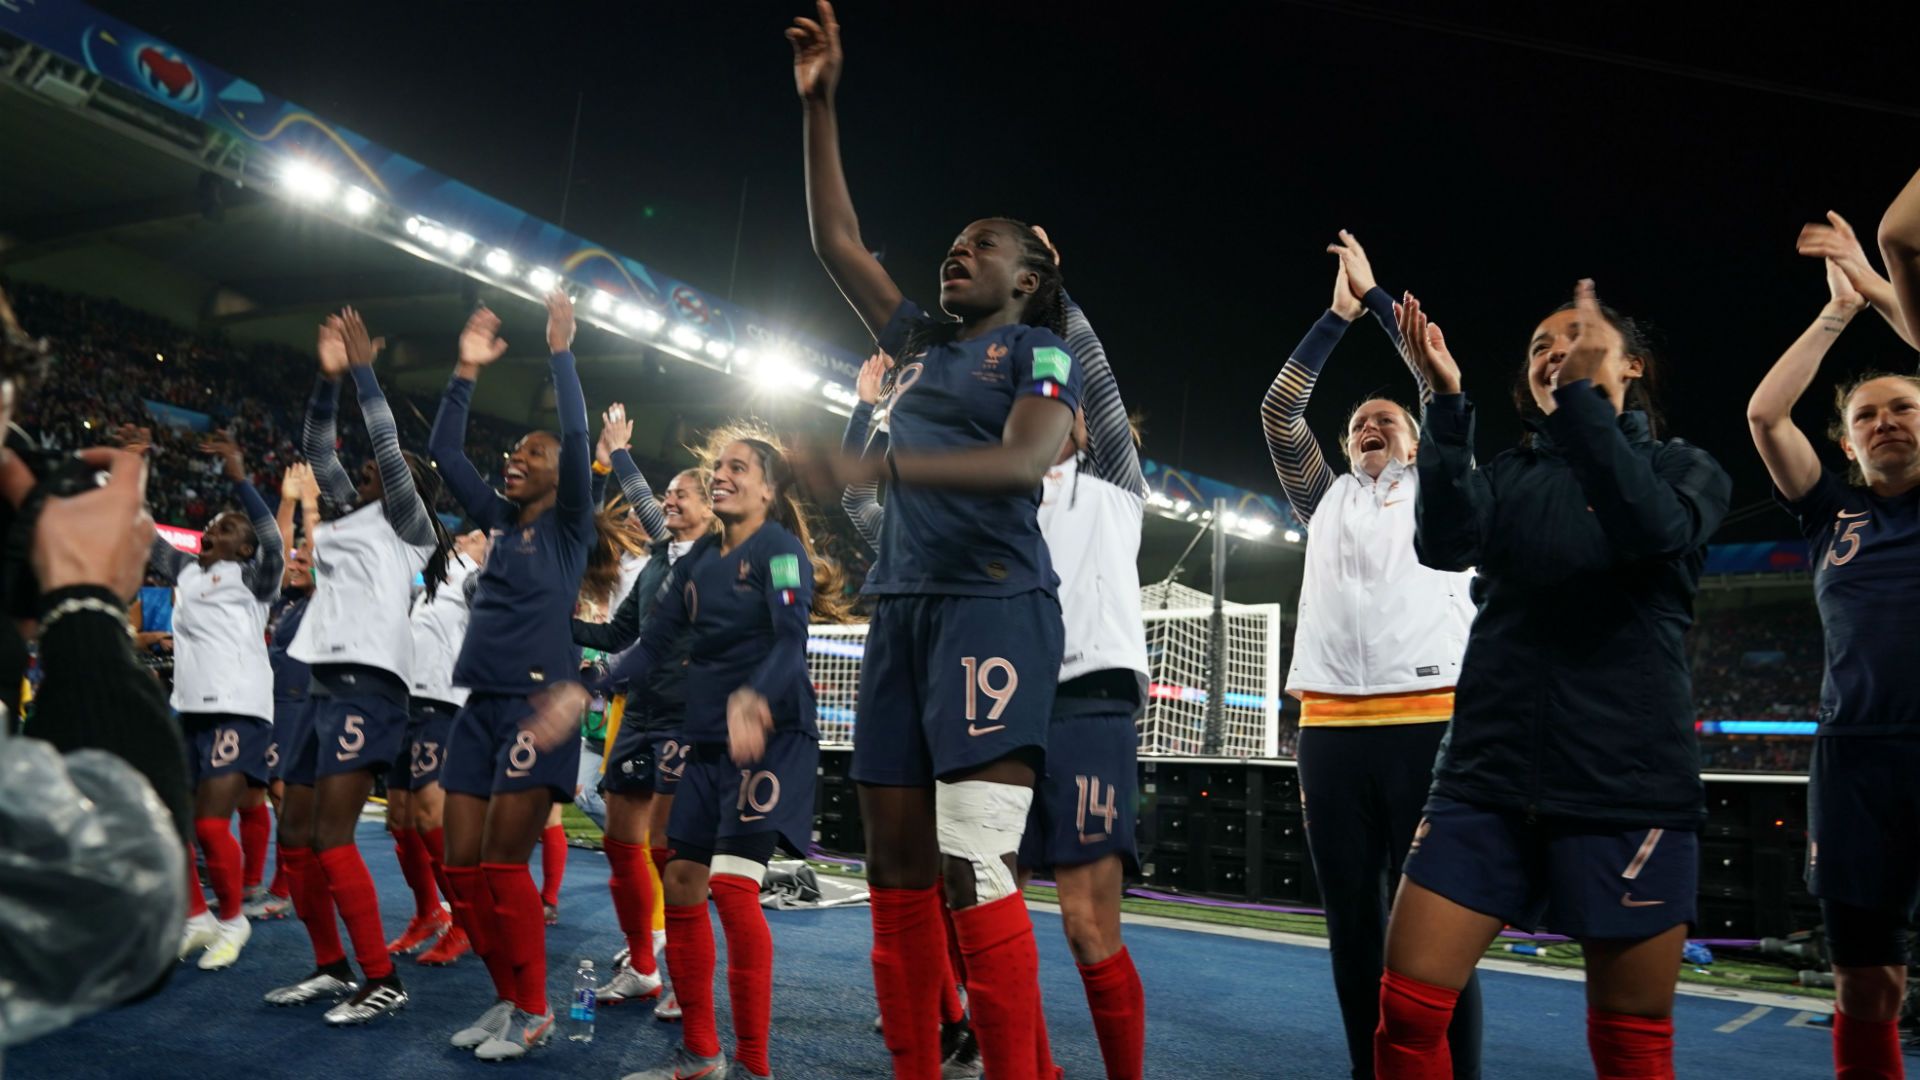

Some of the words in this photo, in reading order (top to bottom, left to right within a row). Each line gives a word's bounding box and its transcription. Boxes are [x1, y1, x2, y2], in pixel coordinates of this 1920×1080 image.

[1822, 519, 1870, 571] 15
[961, 656, 1019, 721] 19
[211, 728, 240, 763] 18
[338, 714, 366, 753] 5
[509, 730, 537, 771] 8
[736, 769, 781, 813] 10
[1075, 775, 1118, 835] 14
